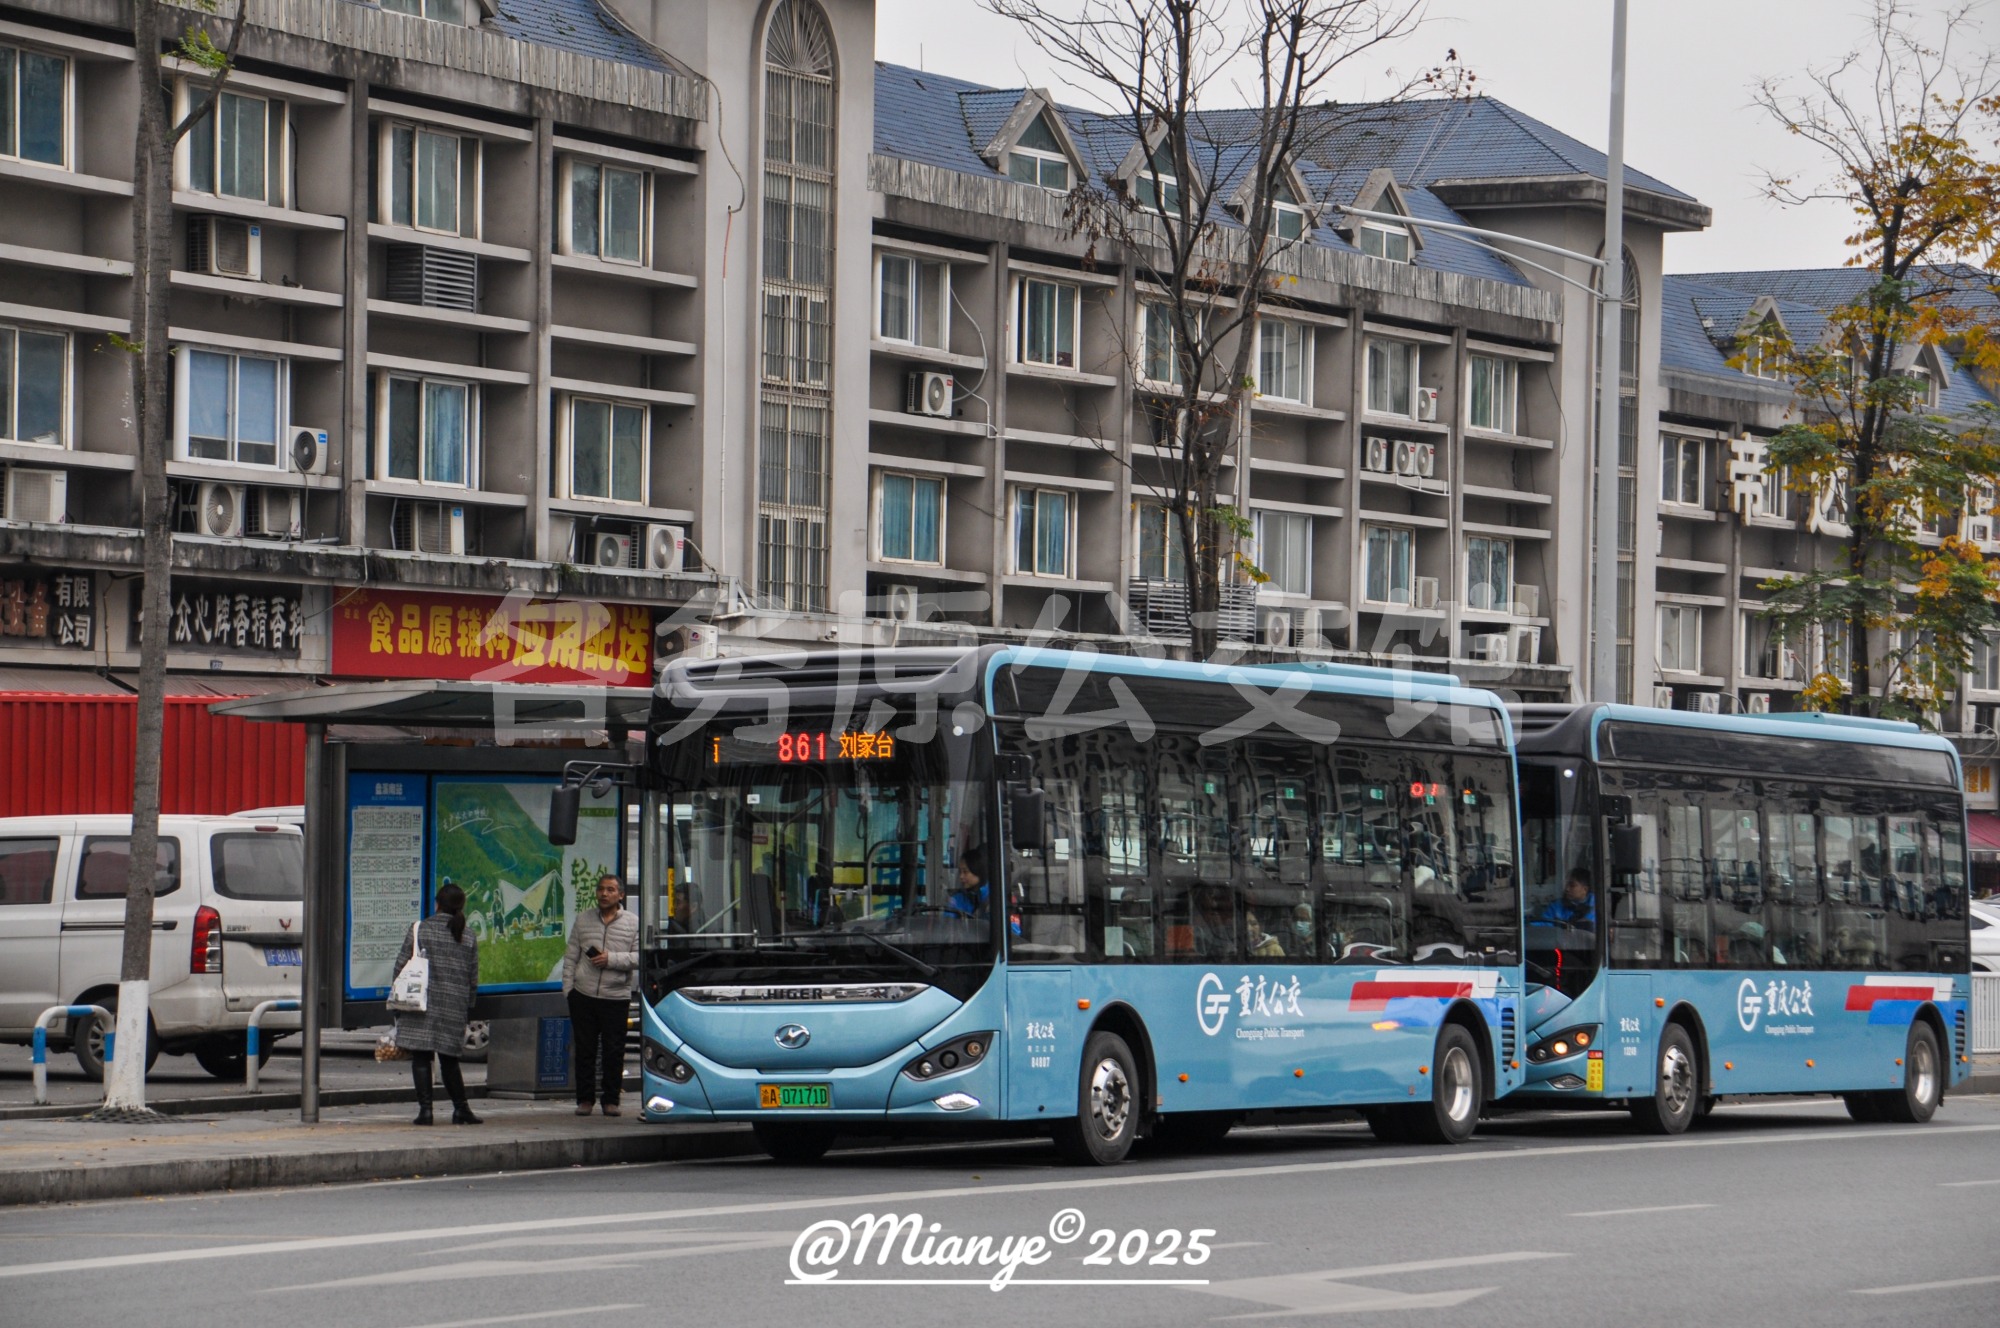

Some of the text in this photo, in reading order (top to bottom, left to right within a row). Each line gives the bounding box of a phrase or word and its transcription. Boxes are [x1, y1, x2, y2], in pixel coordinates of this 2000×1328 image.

[55, 574, 90, 608] 有限
[56, 612, 91, 647] 公司
[367, 599, 650, 675] 食品原辅料应用配送
[778, 732, 826, 763] 861
[838, 731, 894, 760] 刘家台
[766, 988, 823, 1001] HIGER
[1234, 974, 1305, 1017] 重庆公交
[1764, 980, 1815, 1017] 重庆公交
[1025, 1021, 1057, 1040] 重庆公交
[1235, 1027, 1305, 1041] Chongqing Public Transport
